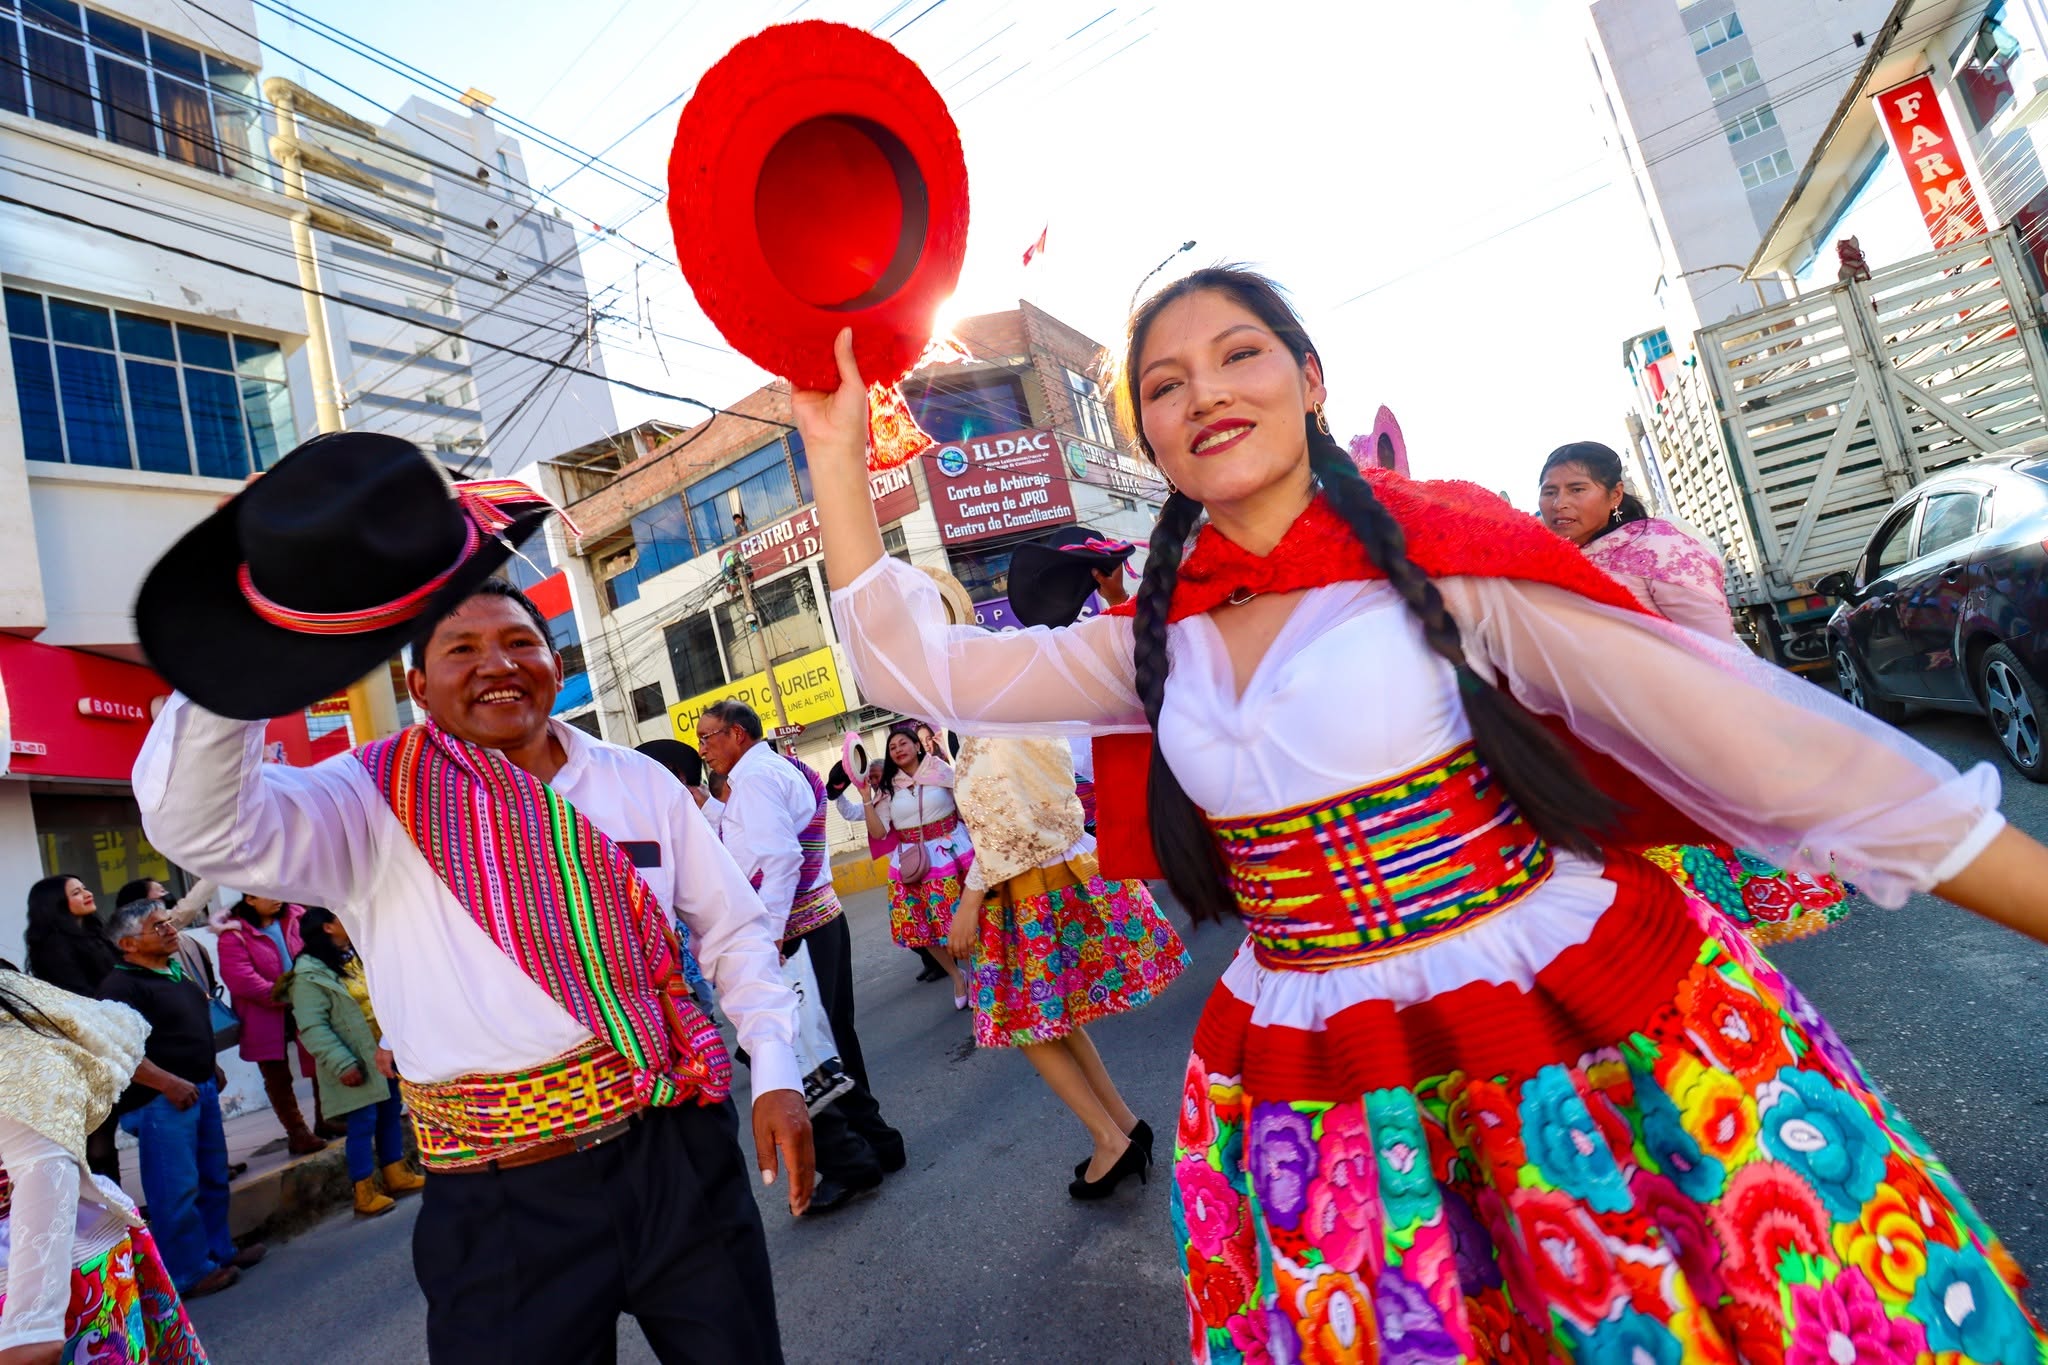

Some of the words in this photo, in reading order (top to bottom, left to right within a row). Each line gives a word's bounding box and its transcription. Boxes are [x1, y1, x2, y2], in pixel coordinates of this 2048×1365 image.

[972, 433, 1050, 461] ILDAC
[947, 486, 981, 501] Corte
[983, 480, 998, 494] de
[1000, 472, 1051, 492] Arbitraje
[959, 503, 1000, 518] Centro
[1002, 496, 1017, 511] de
[1019, 489, 1049, 507] JPRD
[944, 523, 985, 539] Centro
[988, 516, 1003, 531] de
[1003, 505, 1072, 528] Conciliación
[740, 520, 794, 560] CENTRO
[796, 520, 811, 535] DE
[93, 699, 144, 719] BOTICA
[788, 700, 804, 712] UNE
[804, 698, 814, 707] AL
[779, 725, 801, 735] ILDAC
